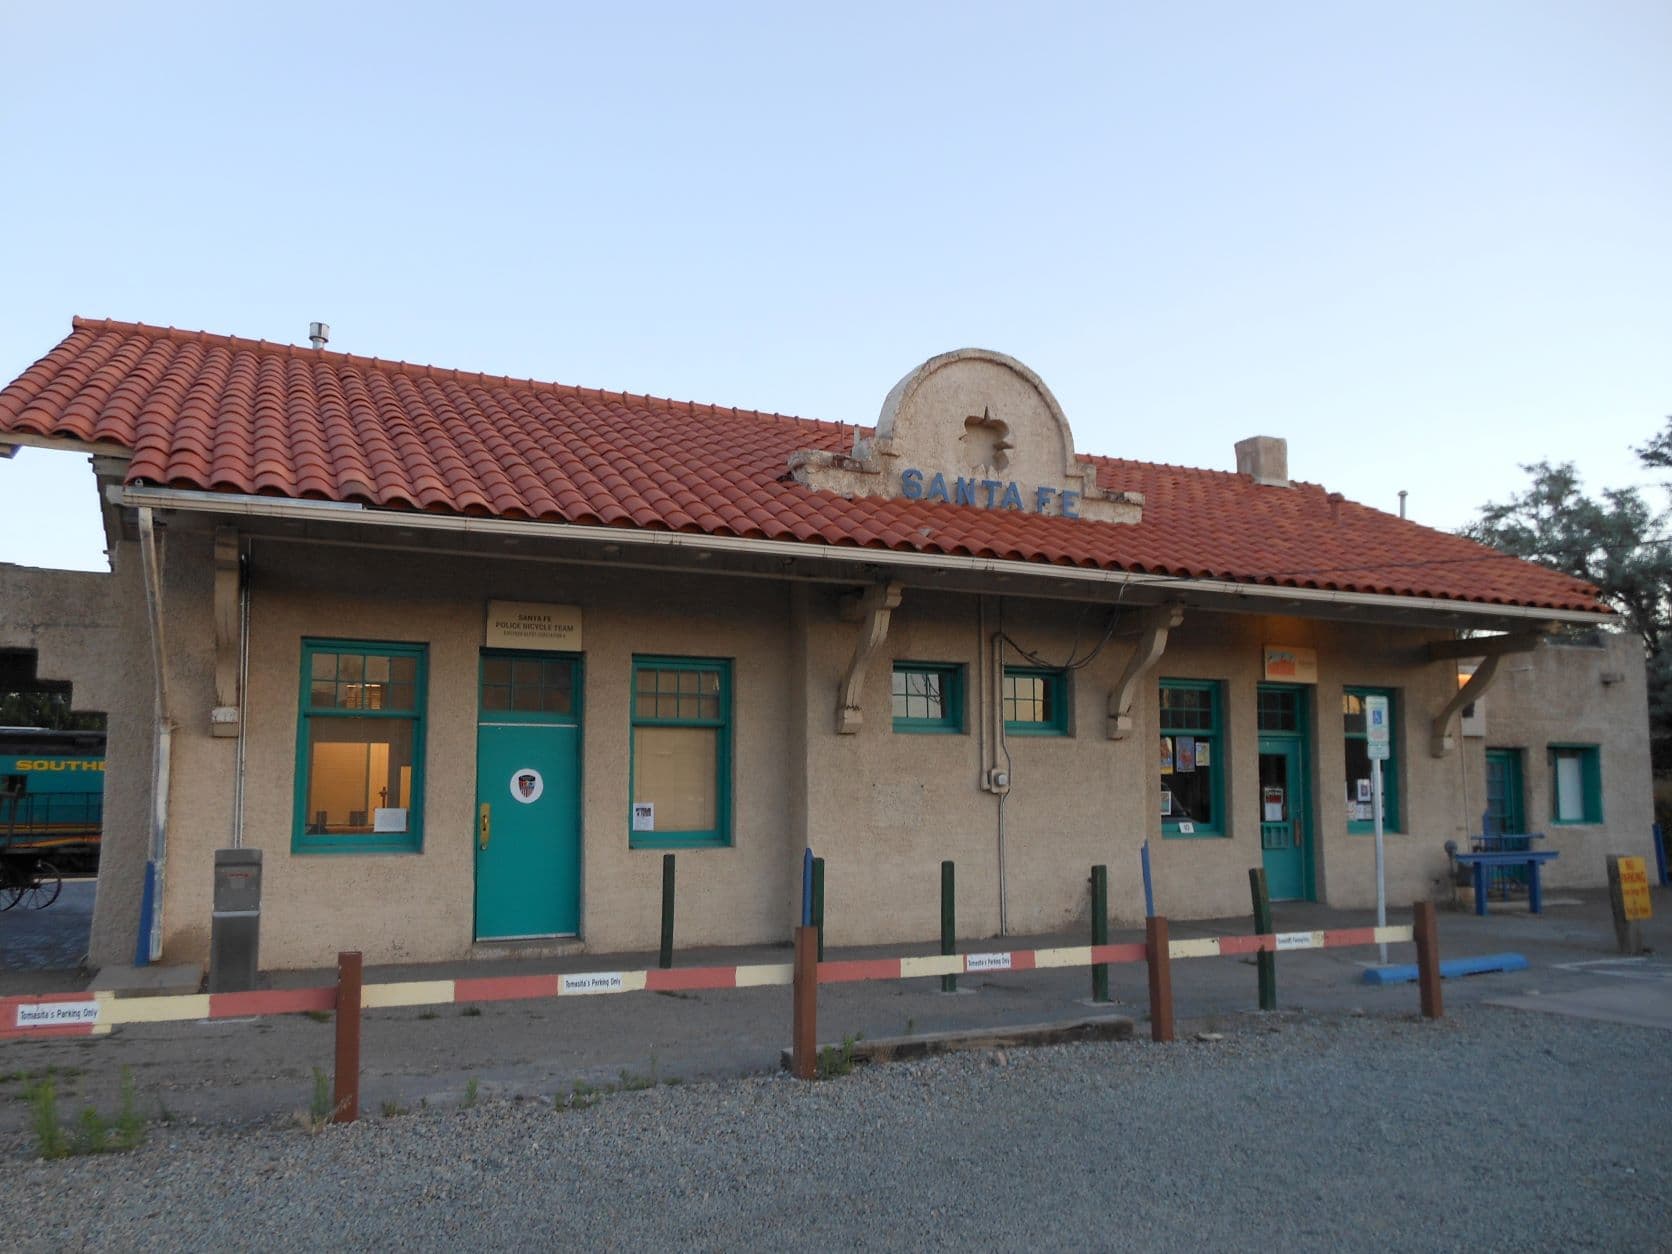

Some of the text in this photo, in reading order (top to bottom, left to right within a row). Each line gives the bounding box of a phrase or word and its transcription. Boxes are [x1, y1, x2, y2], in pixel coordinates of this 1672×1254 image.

[902, 468, 1081, 519] SANTA FE
[496, 622, 520, 630] POLICE
[591, 979, 609, 988] Parking
[610, 977, 621, 986] Only
[57, 1009, 81, 1019] Parking
[83, 1008, 98, 1018] Only
